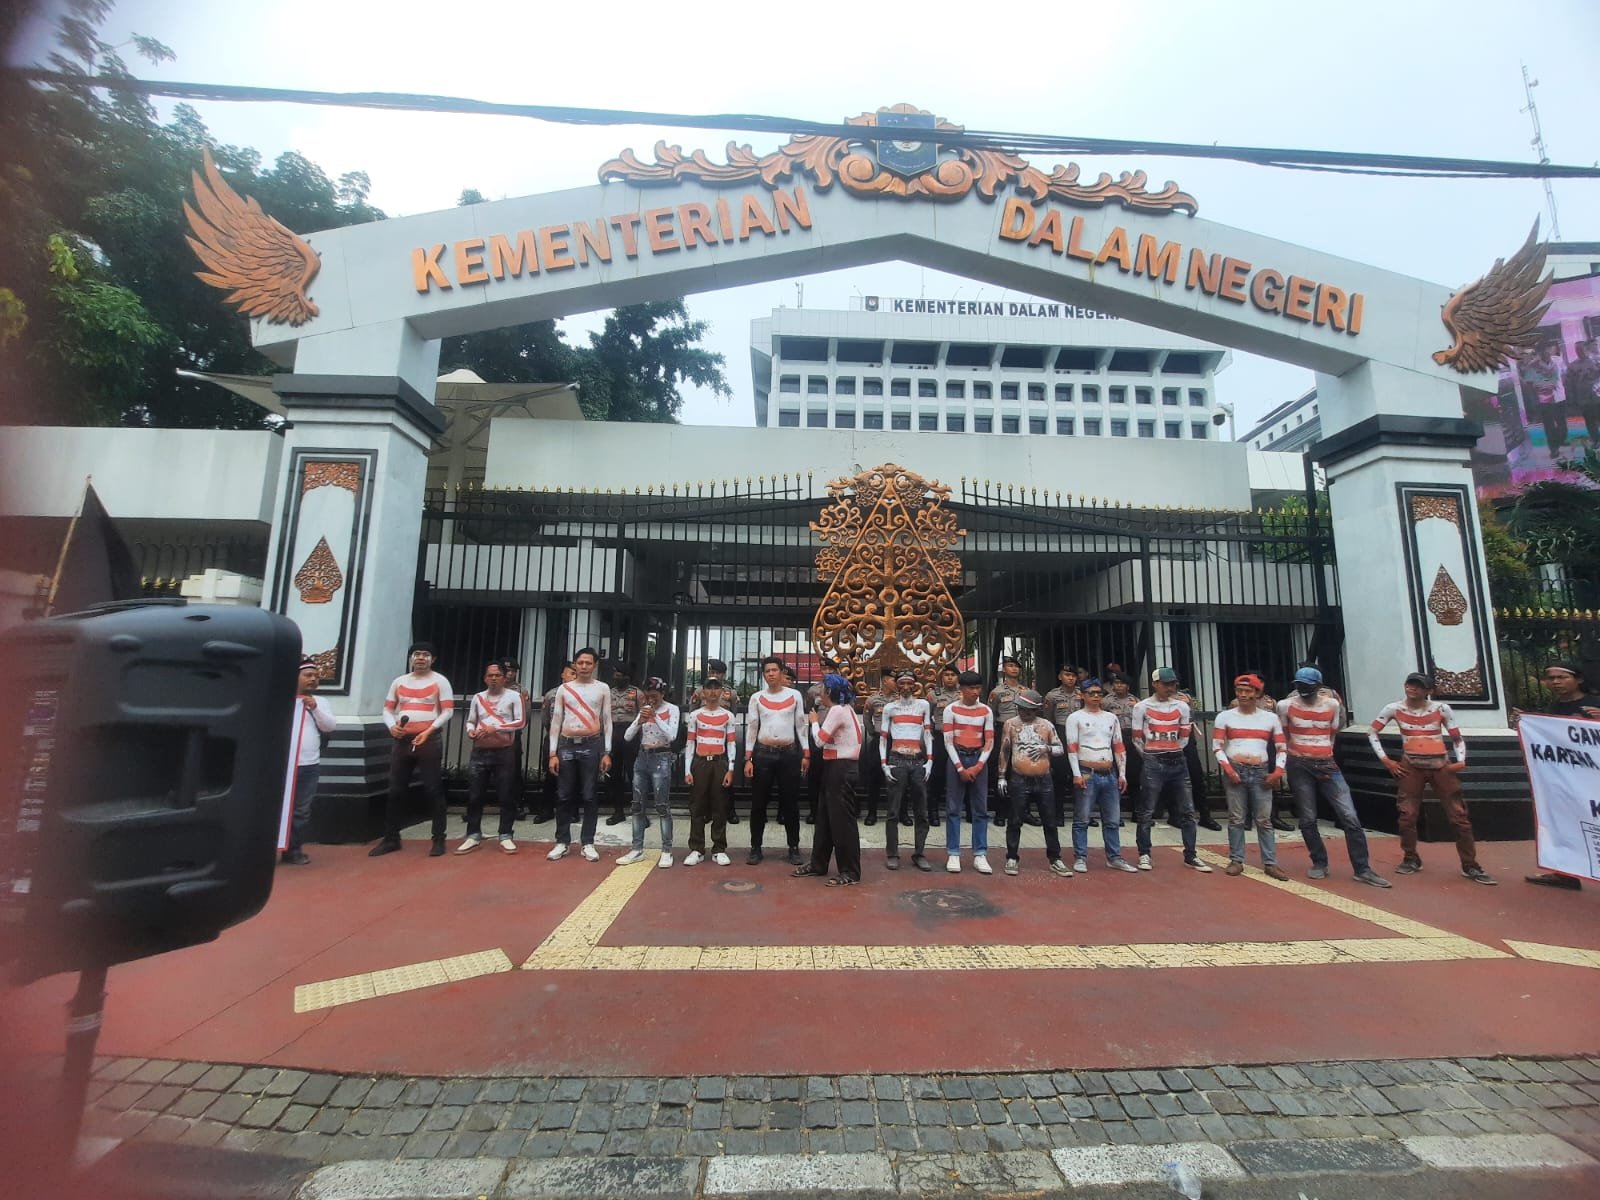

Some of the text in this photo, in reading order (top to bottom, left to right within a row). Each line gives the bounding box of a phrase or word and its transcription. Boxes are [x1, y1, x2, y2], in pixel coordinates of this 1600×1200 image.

[410, 186, 1364, 336] KEMENTERIAN DALAM NEGERI
[894, 299, 1003, 316] KEMENTERIAN
[1009, 302, 1060, 318] DALAM
